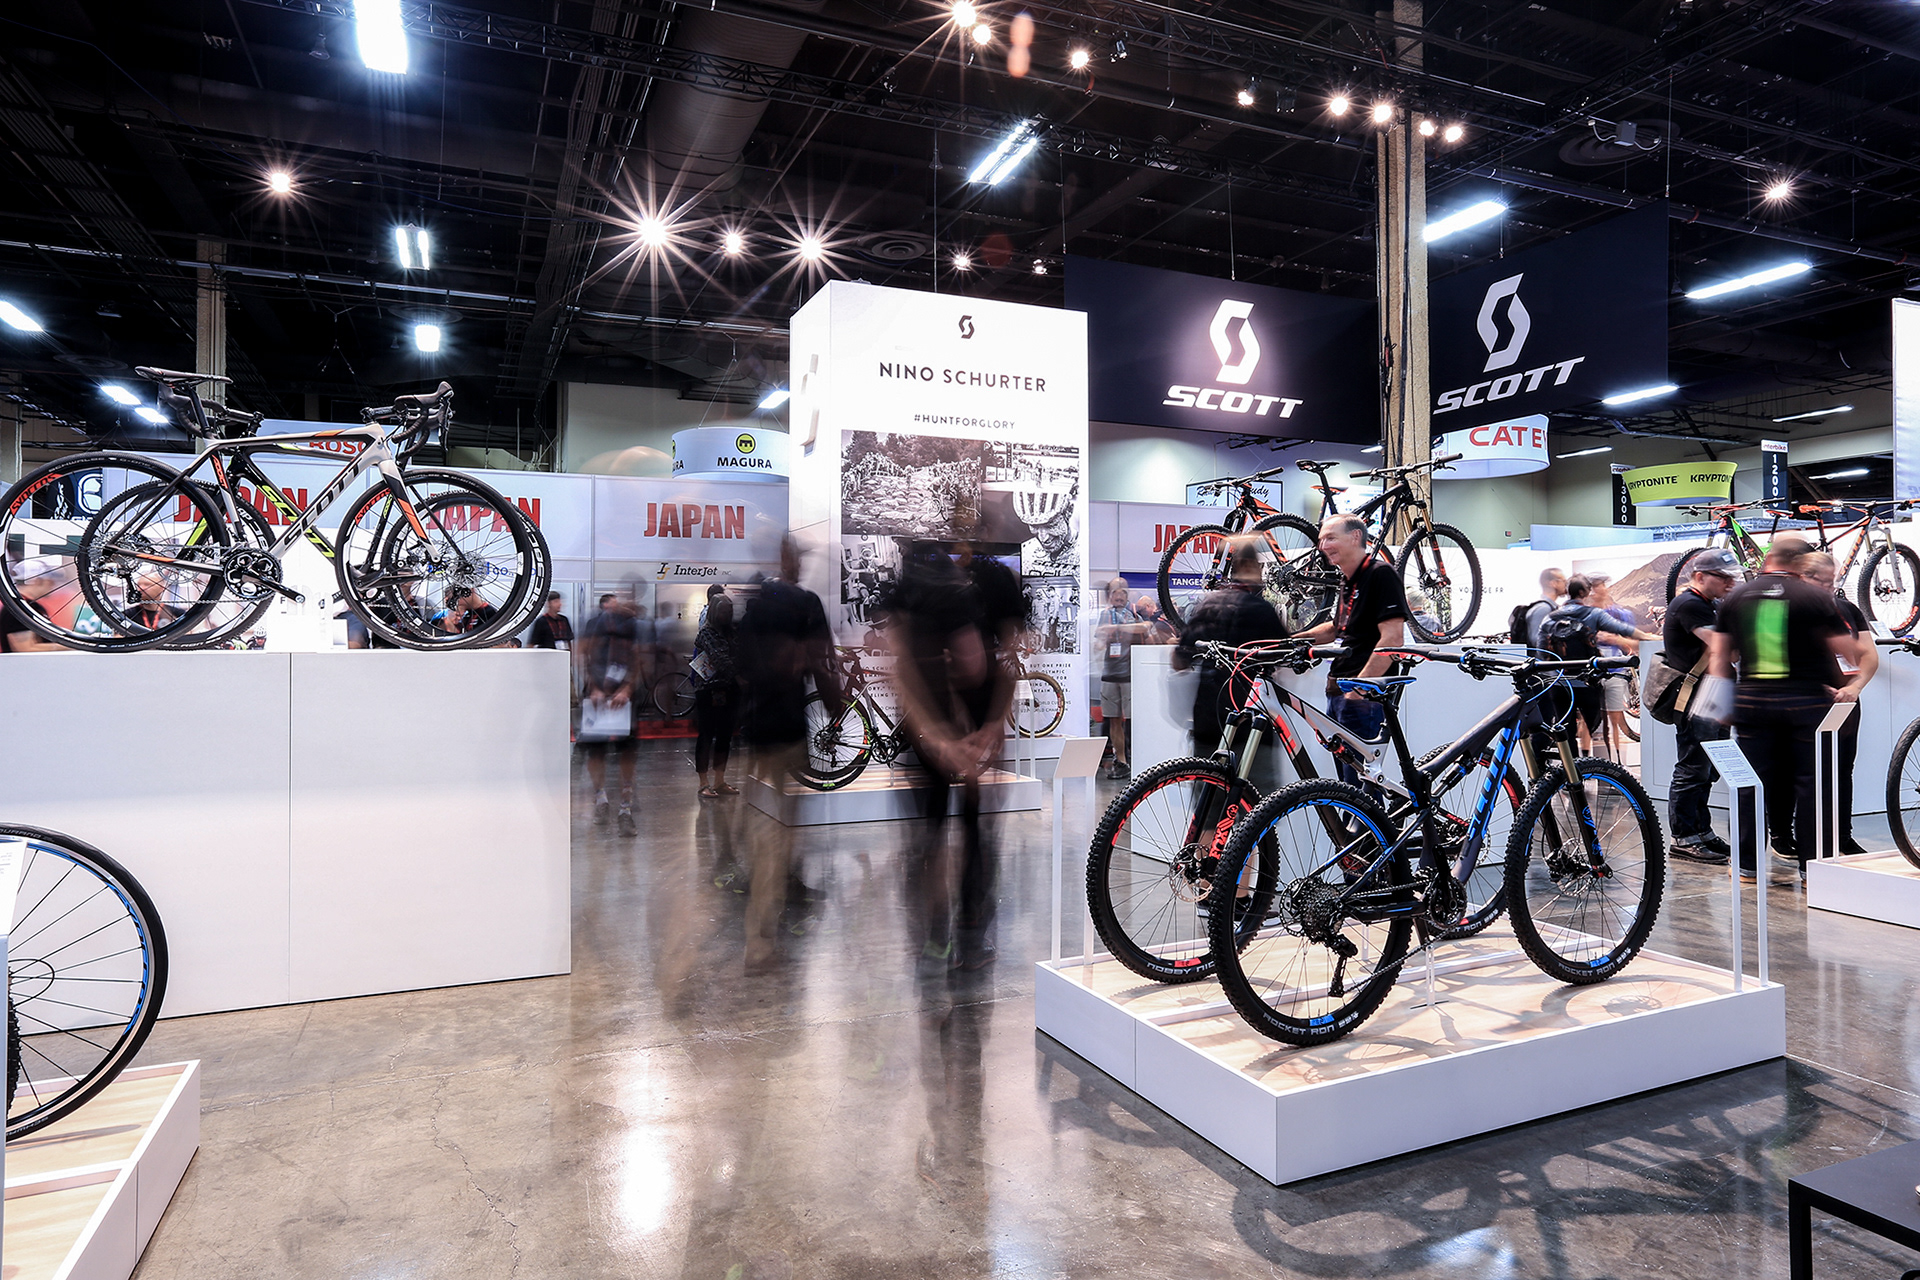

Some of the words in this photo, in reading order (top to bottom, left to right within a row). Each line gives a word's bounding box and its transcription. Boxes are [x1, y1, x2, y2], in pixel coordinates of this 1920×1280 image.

[879, 362, 934, 382] NINO
[943, 369, 1046, 392] SCHURTER
[1433, 356, 1585, 415] SCOTT
[1162, 384, 1304, 419] SCOTT
[914, 414, 1015, 430] #HUNTFORGLORY
[717, 457, 773, 469] MAGURA
[1628, 475, 1678, 491] KRYPTONITE
[283, 457, 363, 551] SCOTT
[256, 484, 336, 558] SCTT
[643, 502, 746, 540] JAPAN
[673, 564, 718, 577] InterJet
[1208, 828, 1230, 860] FOX
[1146, 962, 1192, 976] NOBBY
[1558, 962, 1594, 976] ROCKET
[1597, 962, 1616, 975] RON
[1262, 1012, 1307, 1036] ROCKET
[1310, 1024, 1335, 1036] RON
